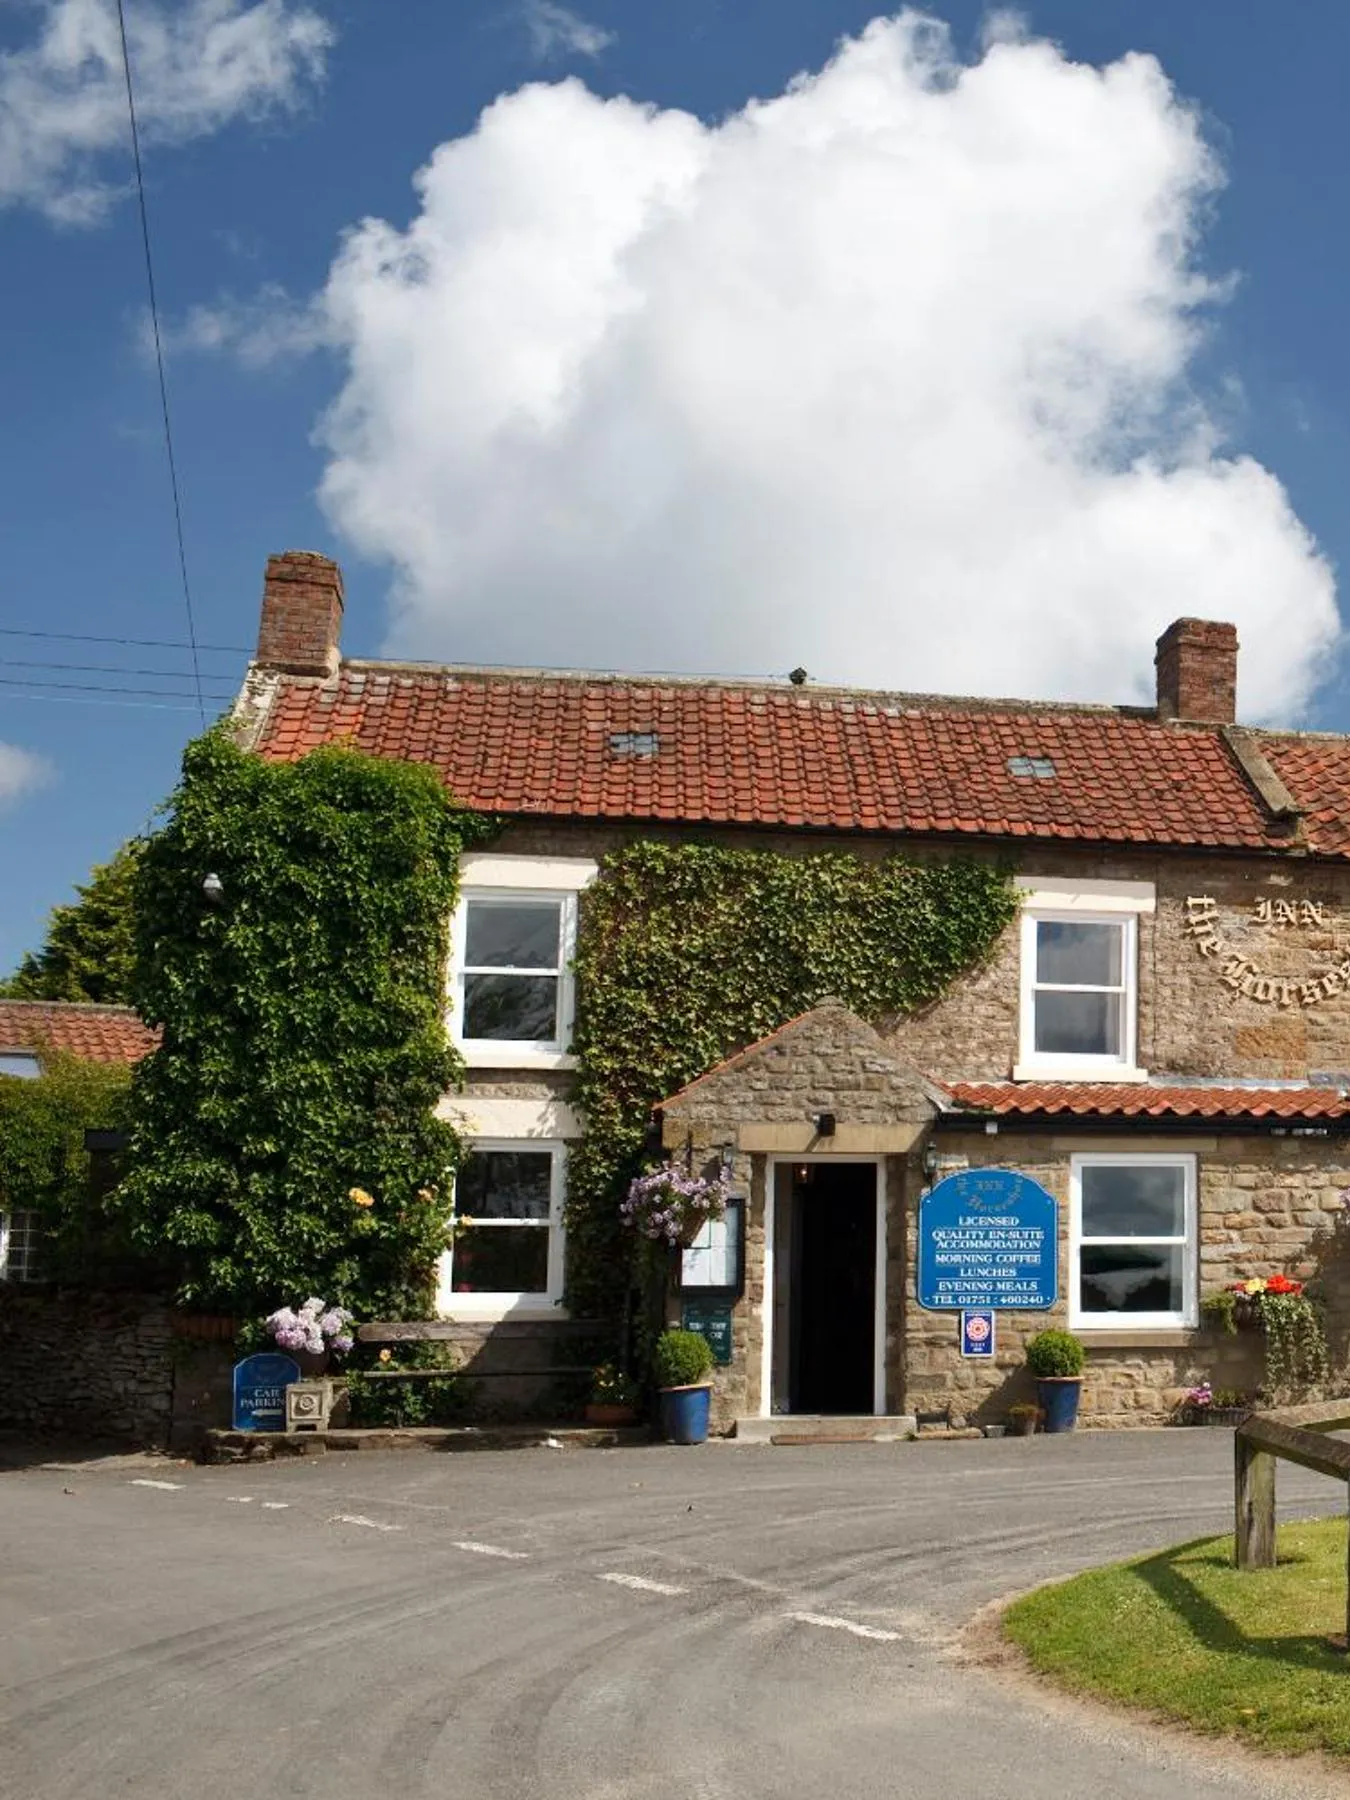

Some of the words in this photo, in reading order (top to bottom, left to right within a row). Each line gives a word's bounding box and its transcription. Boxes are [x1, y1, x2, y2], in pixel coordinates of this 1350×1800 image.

[958, 1215, 1019, 1226] LICENSED
[932, 1231, 985, 1240] QUALITY
[989, 1230, 1044, 1239] EN-SUITE
[936, 1240, 1041, 1249] ACCOMMODATION
[936, 1254, 993, 1263] MORNING
[996, 1254, 1041, 1263] COFFEE
[960, 1268, 1017, 1277] LUNCHES
[939, 1281, 993, 1291] EVENING
[996, 1281, 1038, 1291] MEALS
[958, 1295, 991, 1304] 01751
[254, 1389, 280, 1398] CAR
[240, 1398, 285, 1409] PARKIN
